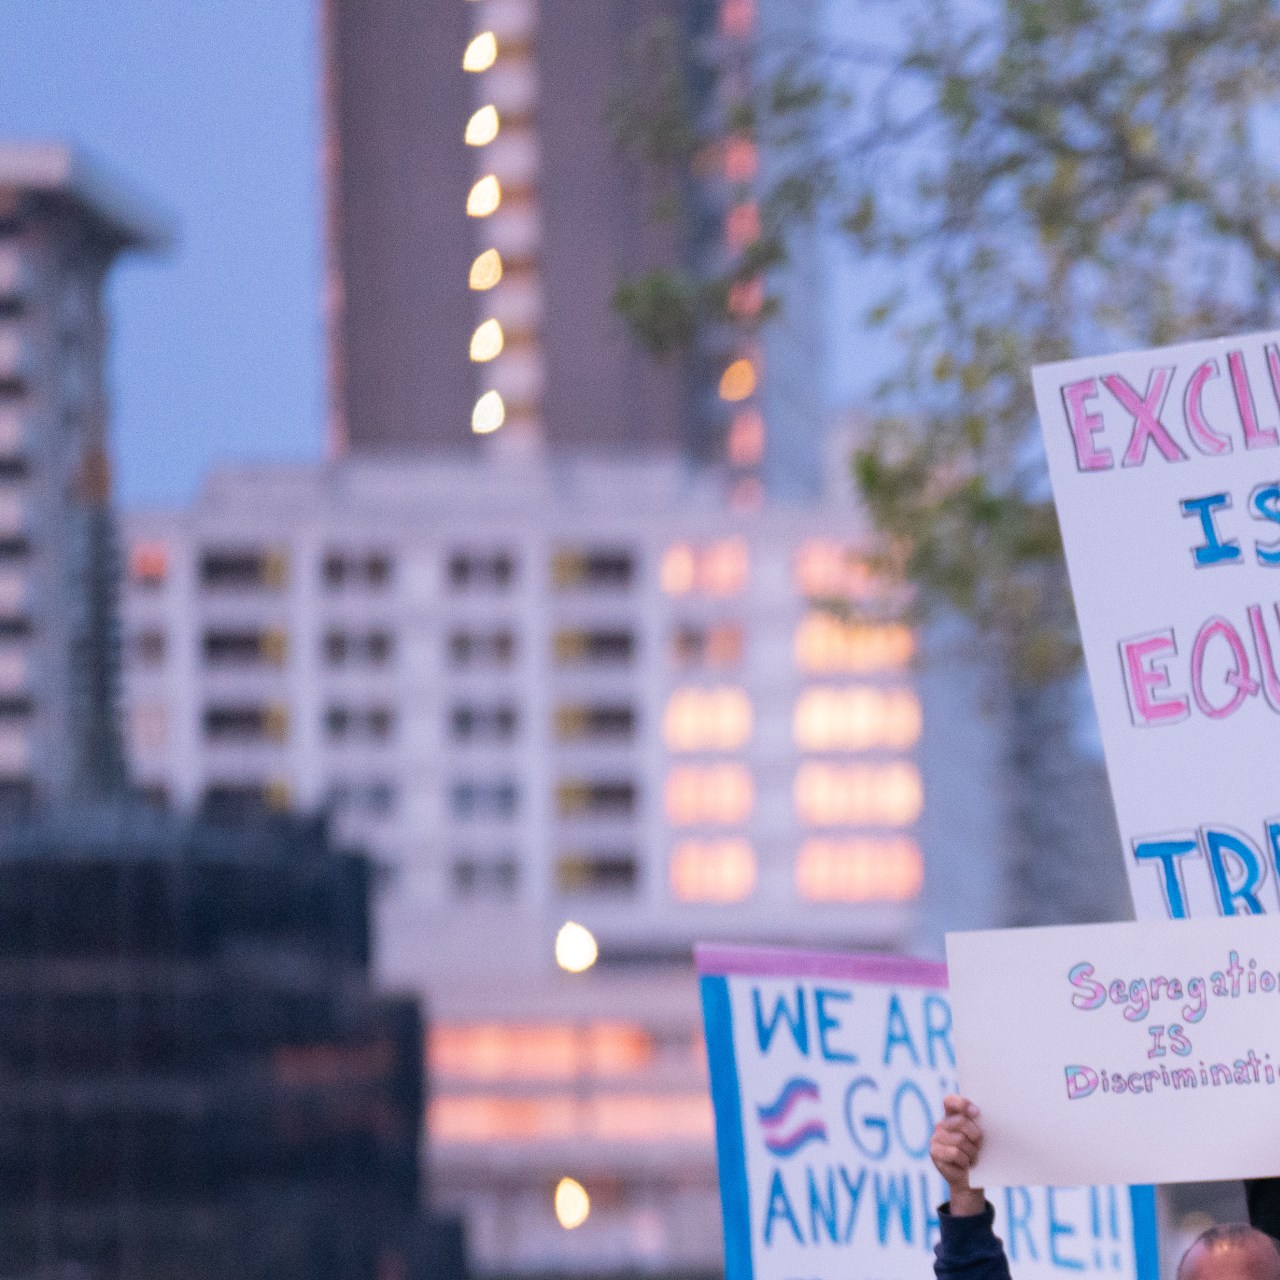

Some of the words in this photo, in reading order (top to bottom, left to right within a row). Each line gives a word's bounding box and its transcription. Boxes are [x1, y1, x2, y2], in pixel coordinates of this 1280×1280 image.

[750, 985, 858, 1065] WE
[884, 993, 957, 1069] AR
[1148, 1024, 1193, 1059] IS
